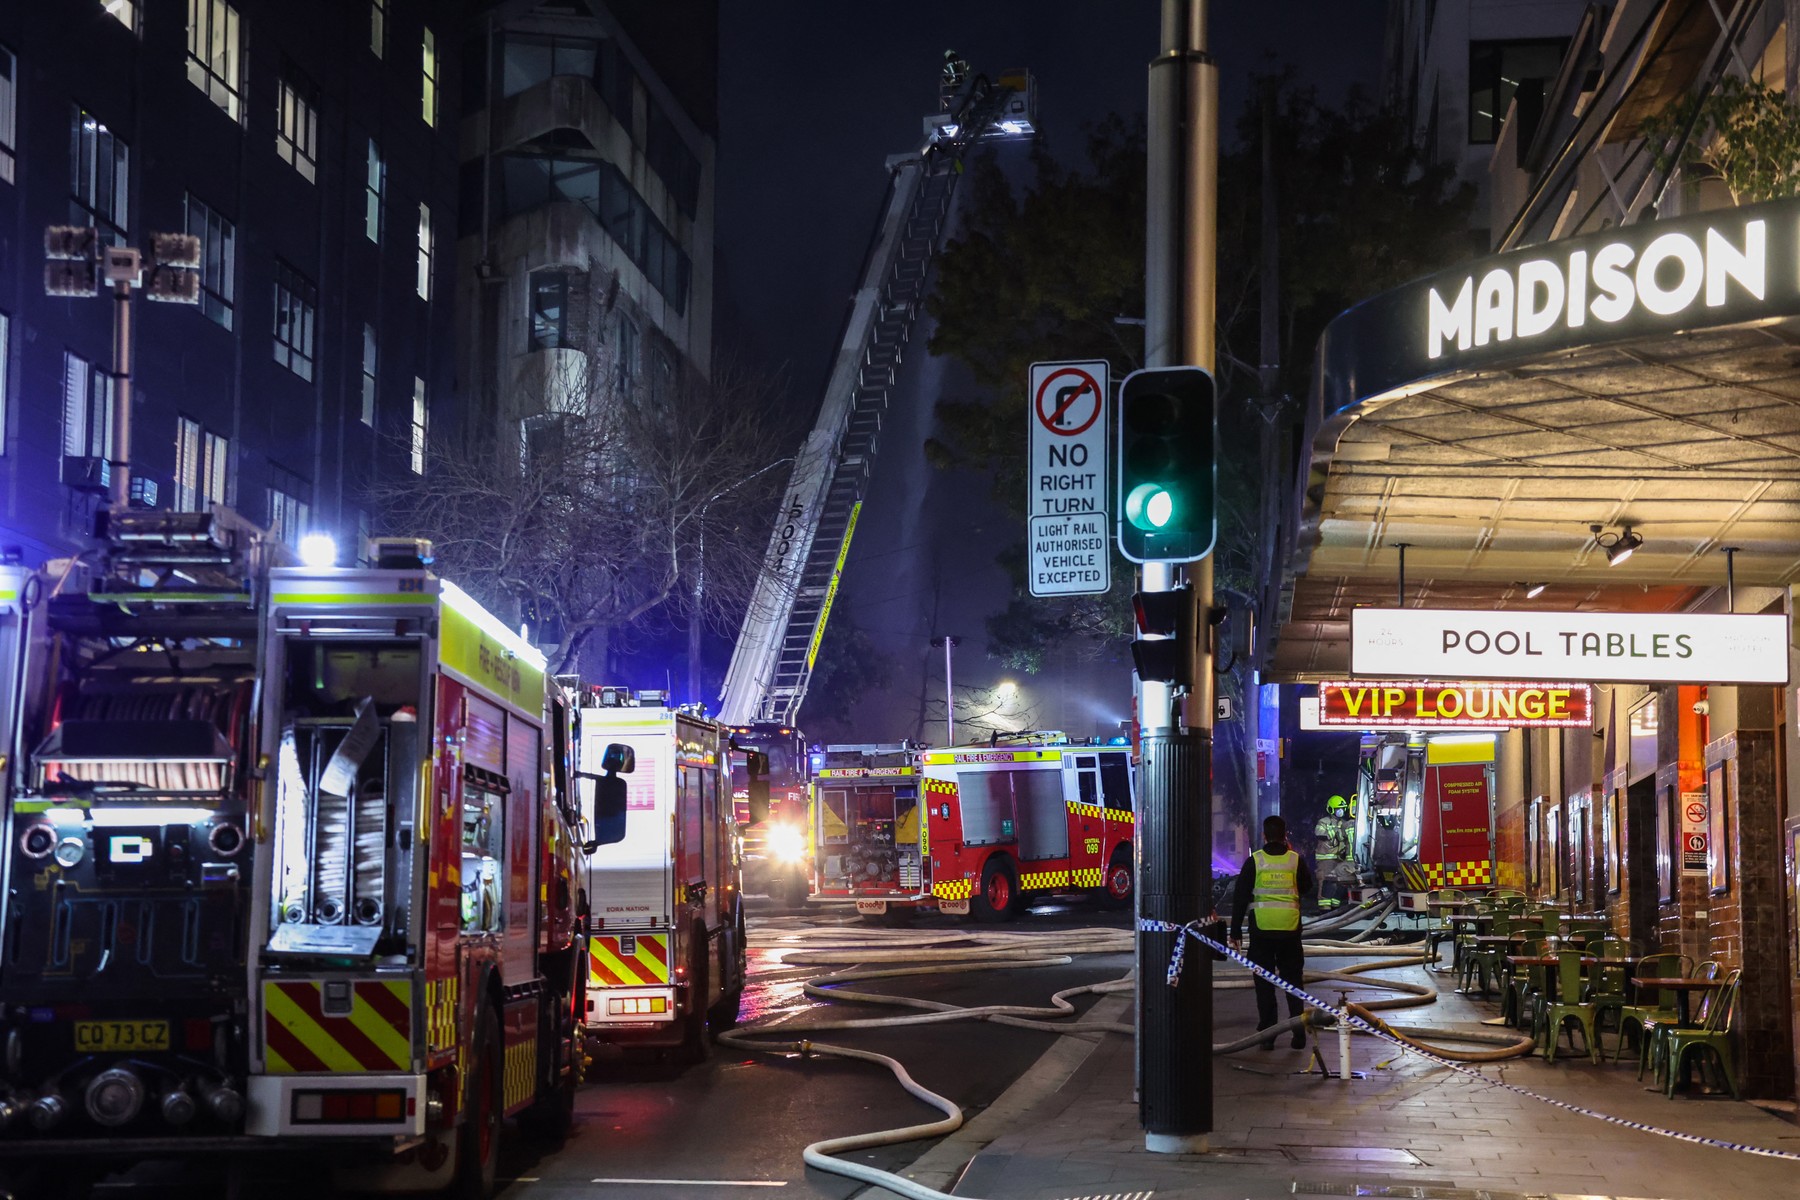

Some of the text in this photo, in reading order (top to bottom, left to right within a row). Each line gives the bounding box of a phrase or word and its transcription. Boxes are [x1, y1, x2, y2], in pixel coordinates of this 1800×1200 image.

[1428, 219, 1766, 359] MADISON
[1049, 443, 1088, 467] NO
[1040, 474, 1096, 491] RIGHT
[1043, 497, 1094, 514] TURN
[1038, 521, 1097, 537] LIGHT RAIL
[1036, 536, 1102, 553] AUTHORISED
[1043, 555, 1095, 568] VEHICLE
[1038, 570, 1100, 584] EXCEPTED
[1368, 638, 1404, 647] HOURS
[1442, 630, 1543, 656] POOL
[1558, 632, 1693, 659] TABLES
[1339, 687, 1571, 720] VIP LOUNGE
[983, 752, 1013, 761] EMERGENCY
[831, 769, 844, 777] RAIL
[845, 768, 858, 776] FIRE
[864, 767, 900, 776] EMERGENCY
[1087, 843, 1098, 854] 099
